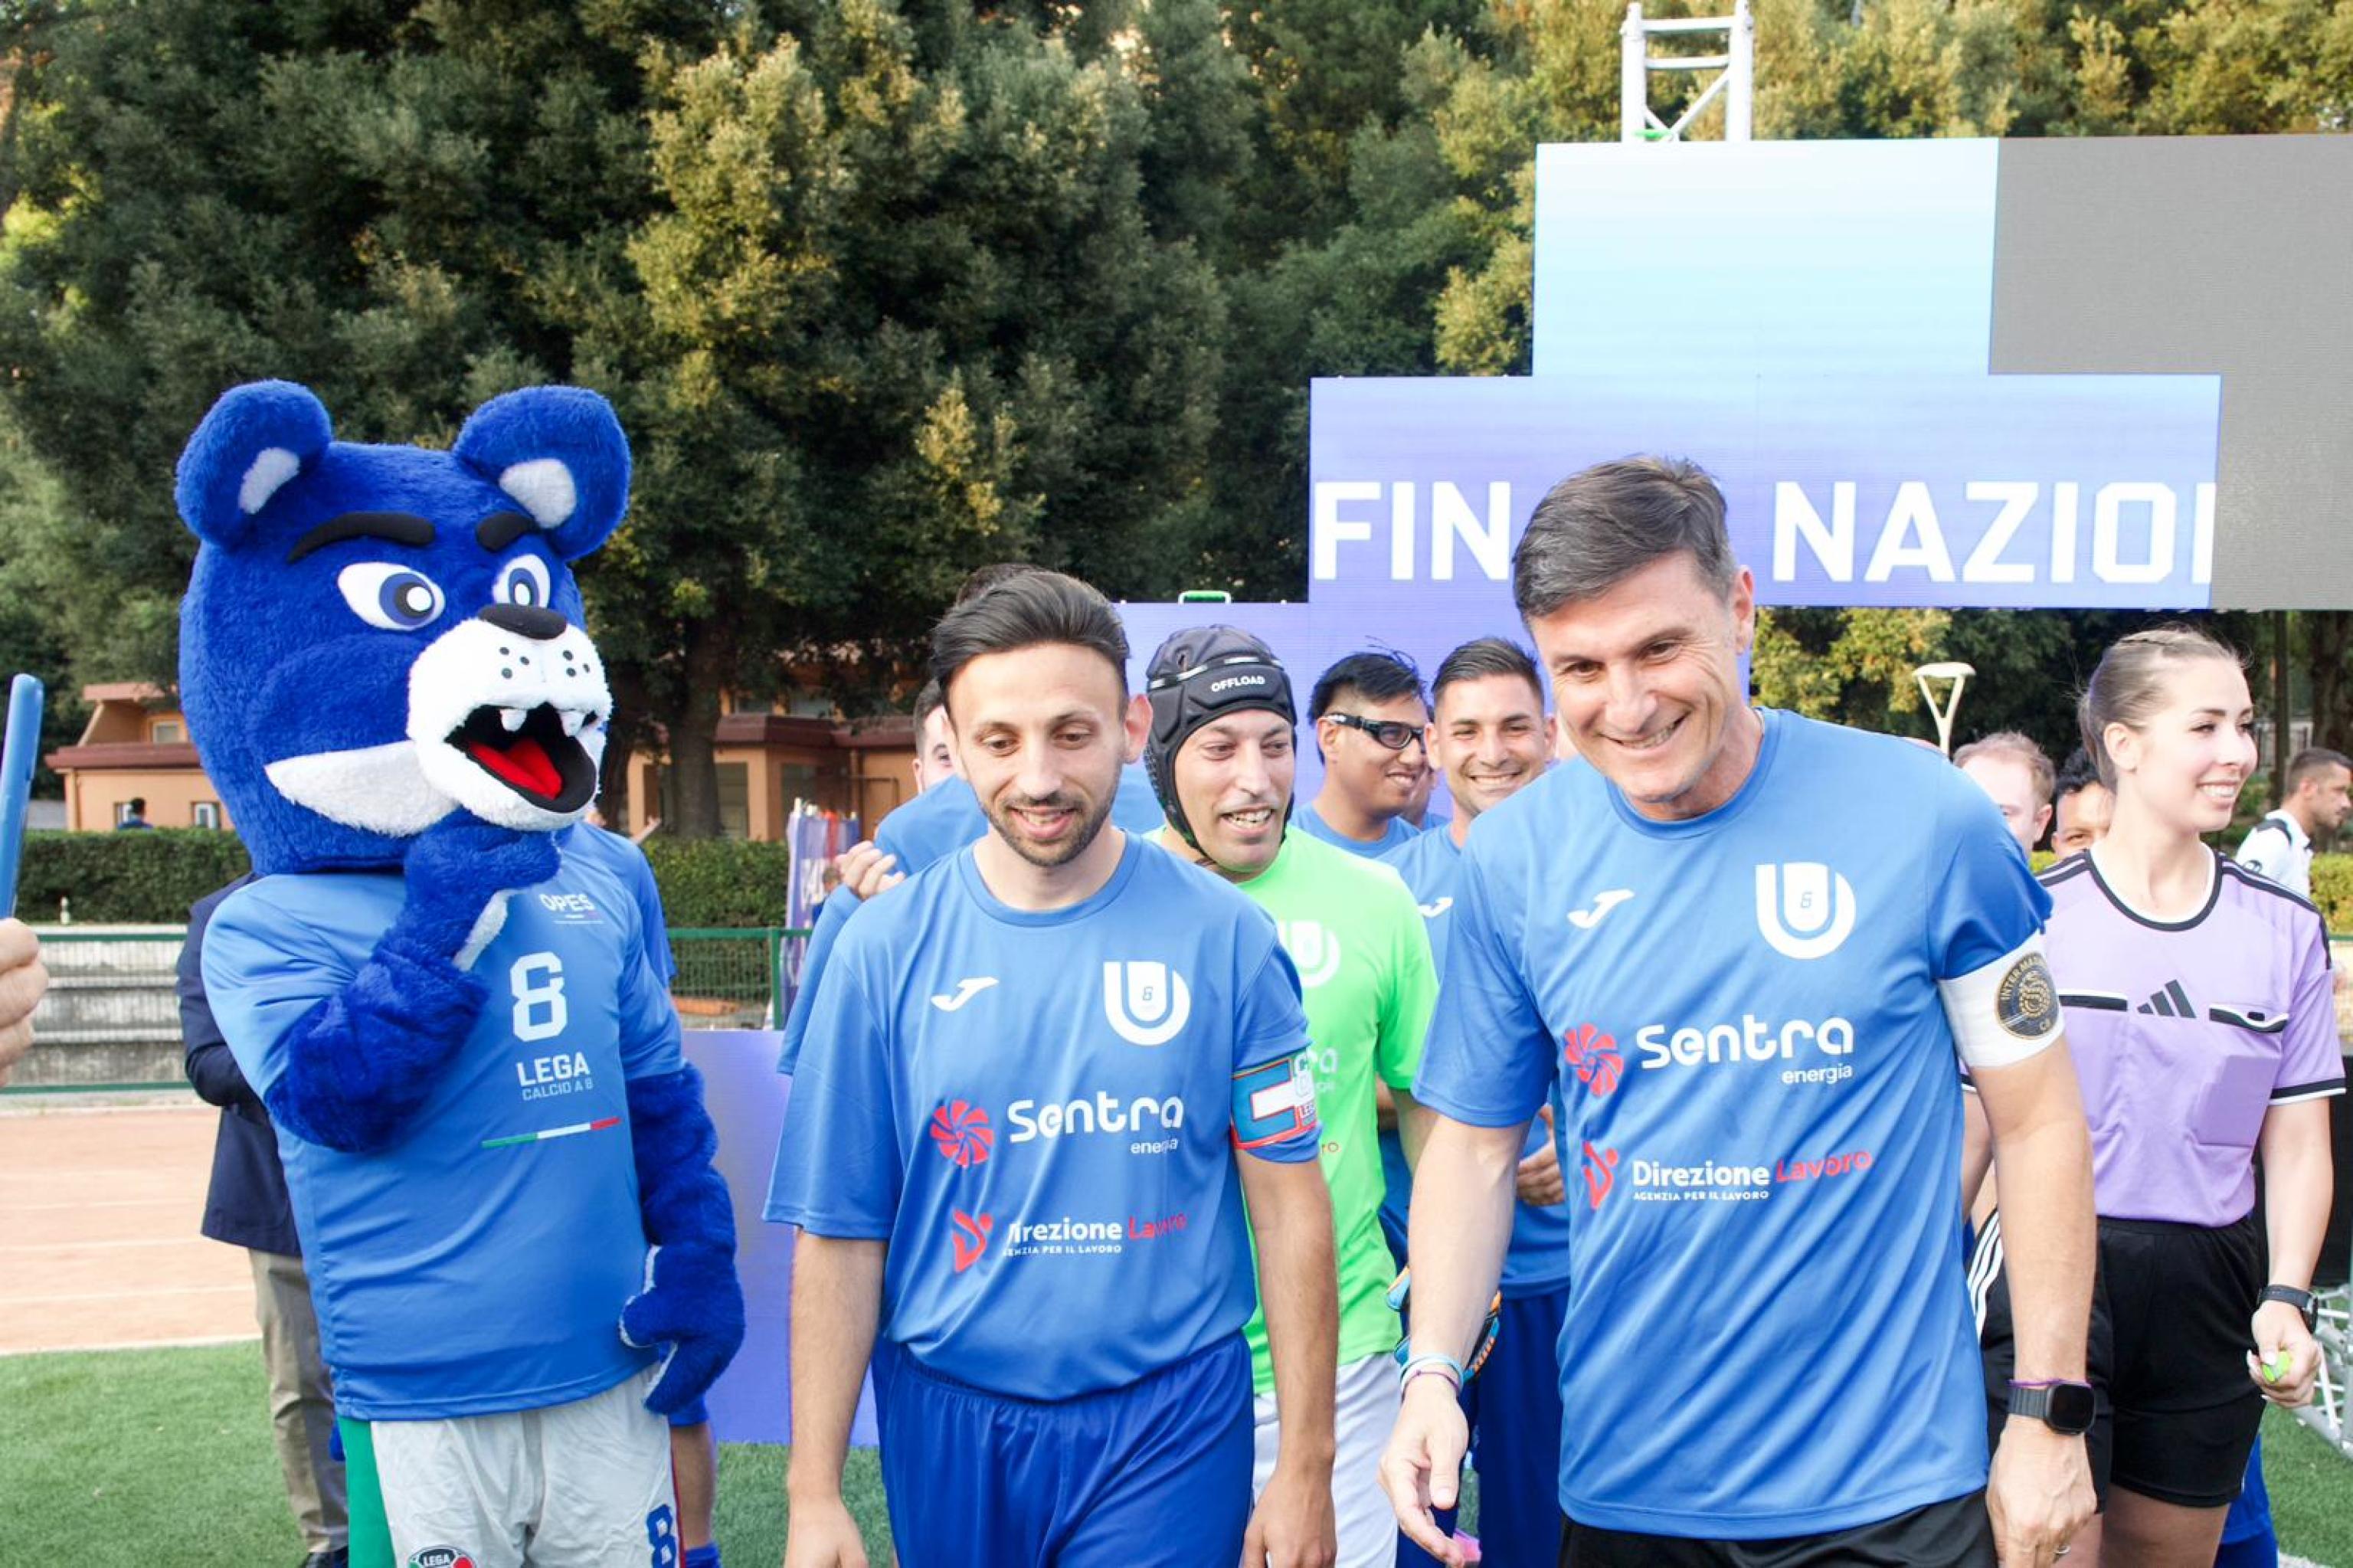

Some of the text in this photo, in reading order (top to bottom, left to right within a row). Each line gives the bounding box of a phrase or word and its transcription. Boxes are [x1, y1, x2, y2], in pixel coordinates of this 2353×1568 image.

[1314, 482, 1511, 581] FIN
[1211, 676, 1265, 692] OFFLOAD
[539, 893, 595, 912] OPES
[516, 1052, 590, 1086] LEGA
[1782, 1063, 1854, 1085] energia
[522, 1082, 571, 1101] CALCIO
[574, 1080, 583, 1092] A
[1632, 1151, 1873, 1187] Direzione Lavoro
[1634, 1190, 1769, 1201] AGENZIA PER IL LAVORO
[1042, 1245, 1062, 1255] PER
[1065, 1245, 1076, 1254] IL
[1078, 1245, 1122, 1254] LAVORO
[647, 1504, 677, 1568] 8
[423, 1553, 452, 1565] LEGA
